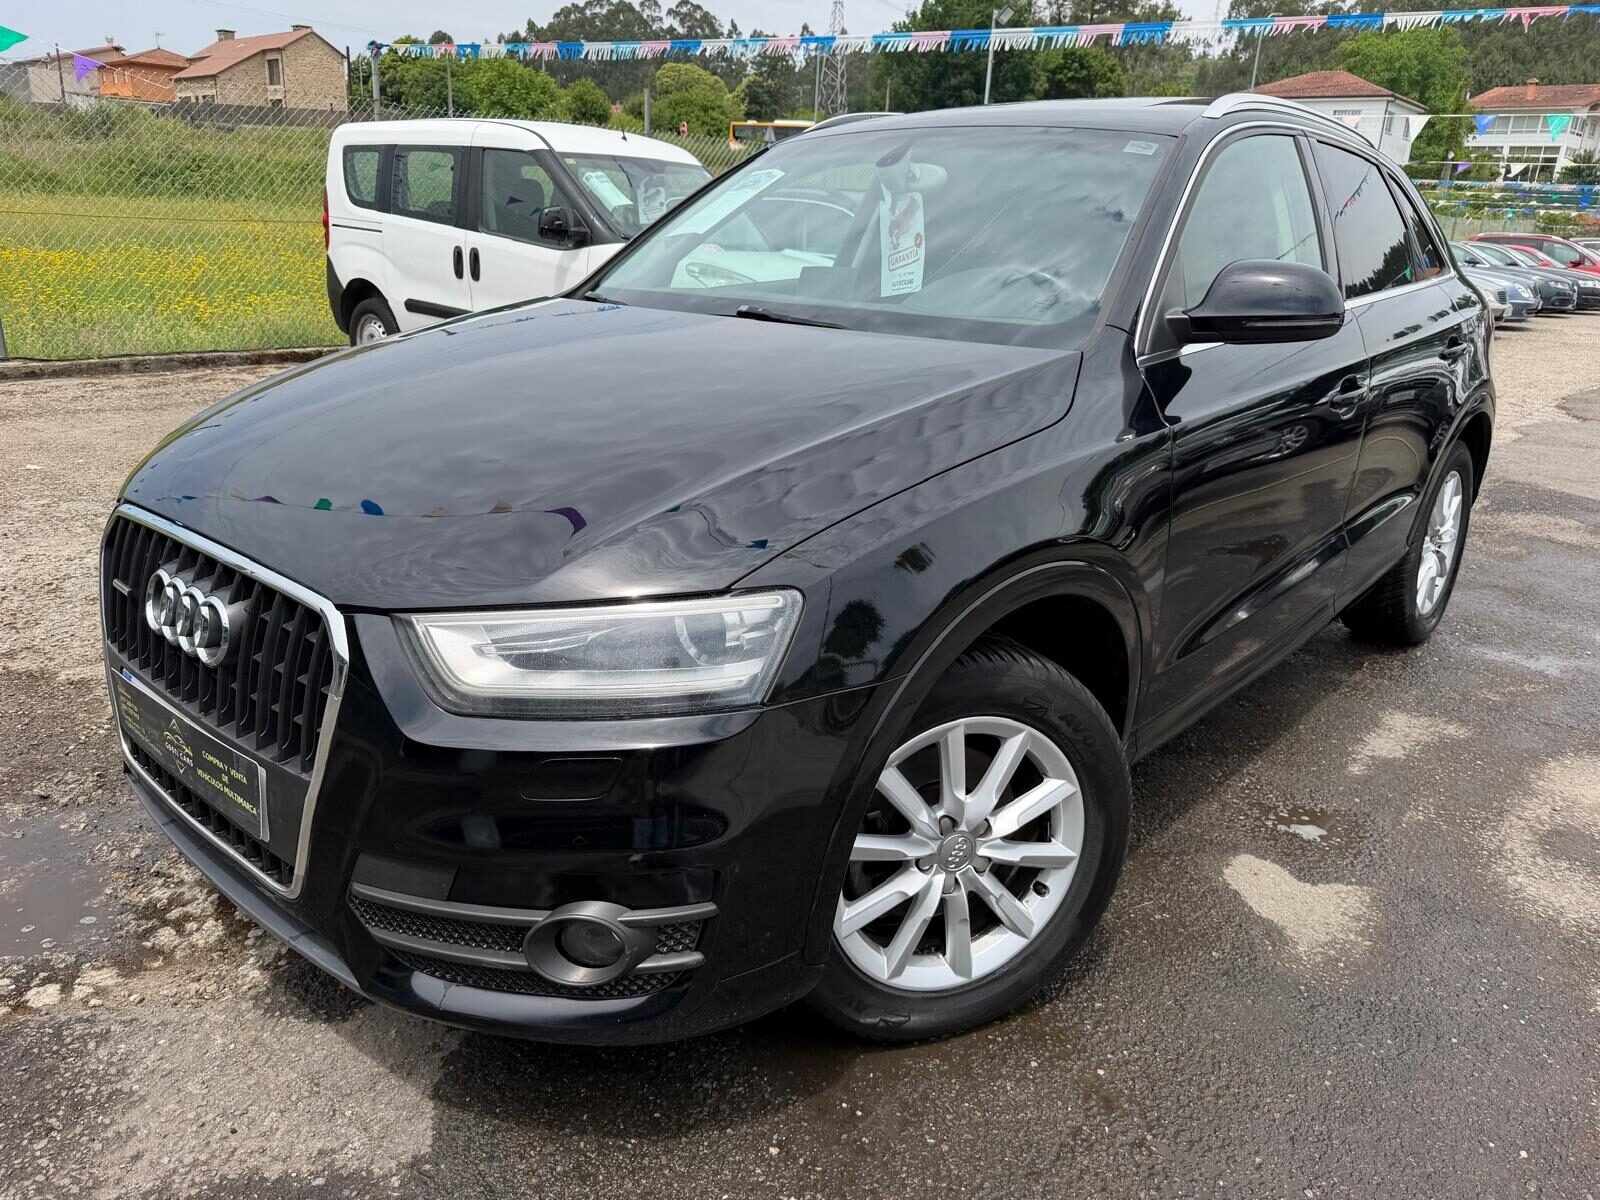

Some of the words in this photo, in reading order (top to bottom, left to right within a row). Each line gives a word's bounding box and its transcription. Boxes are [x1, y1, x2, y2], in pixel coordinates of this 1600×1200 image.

[179, 752, 194, 767] CARS
[201, 750, 224, 770] COMPRA
[229, 767, 248, 785] VENTA
[221, 773, 229, 784] DE
[223, 786, 258, 816] MULTIMARCA
